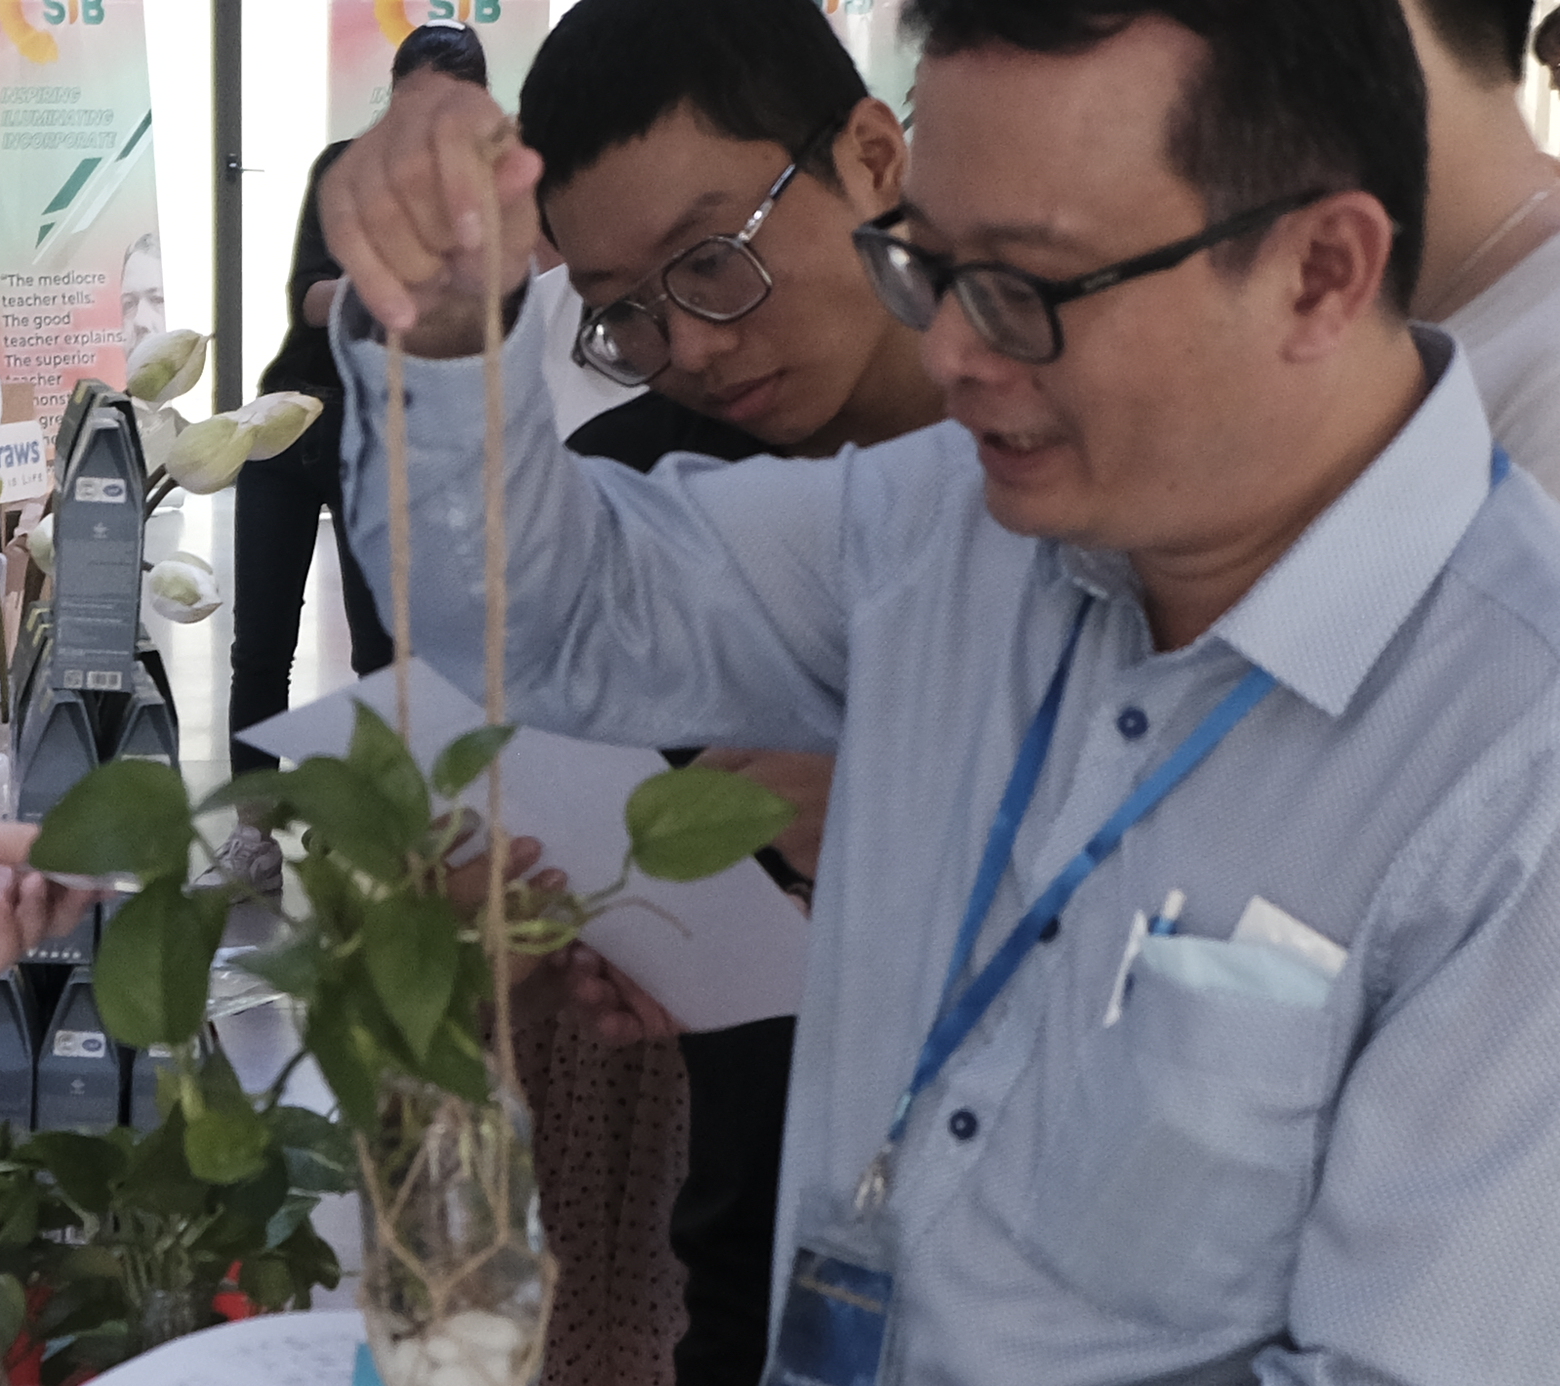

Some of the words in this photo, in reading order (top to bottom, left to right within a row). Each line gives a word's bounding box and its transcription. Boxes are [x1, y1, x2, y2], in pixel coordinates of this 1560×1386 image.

[0, 86, 81, 104] INSPIRING
[1, 109, 114, 127] ILLUMINATING
[2, 131, 118, 150] INCORPORATE
[38, 270, 106, 286] mediocre
[2, 293, 57, 308] teacher
[62, 291, 95, 305] tells.
[3, 314, 30, 328] The
[33, 311, 71, 330] good
[4, 332, 59, 348] teacher
[64, 330, 127, 348] explains.
[5, 354, 32, 368] The
[35, 352, 97, 370] superior
[5, 372, 63, 386] cher
